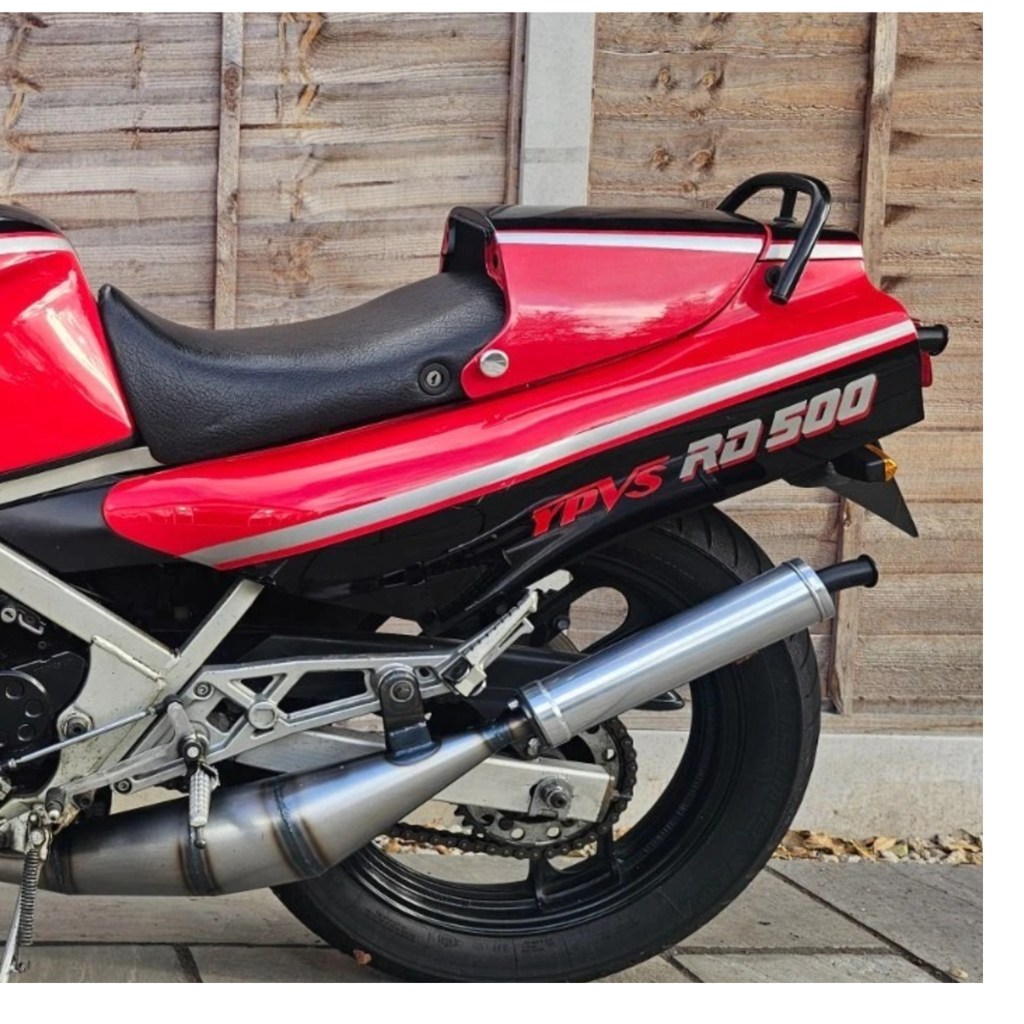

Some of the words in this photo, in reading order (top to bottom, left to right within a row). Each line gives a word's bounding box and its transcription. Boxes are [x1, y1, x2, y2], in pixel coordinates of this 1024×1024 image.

[530, 455, 670, 537] YPVS
[679, 418, 763, 482] RD
[765, 374, 878, 452] 500
